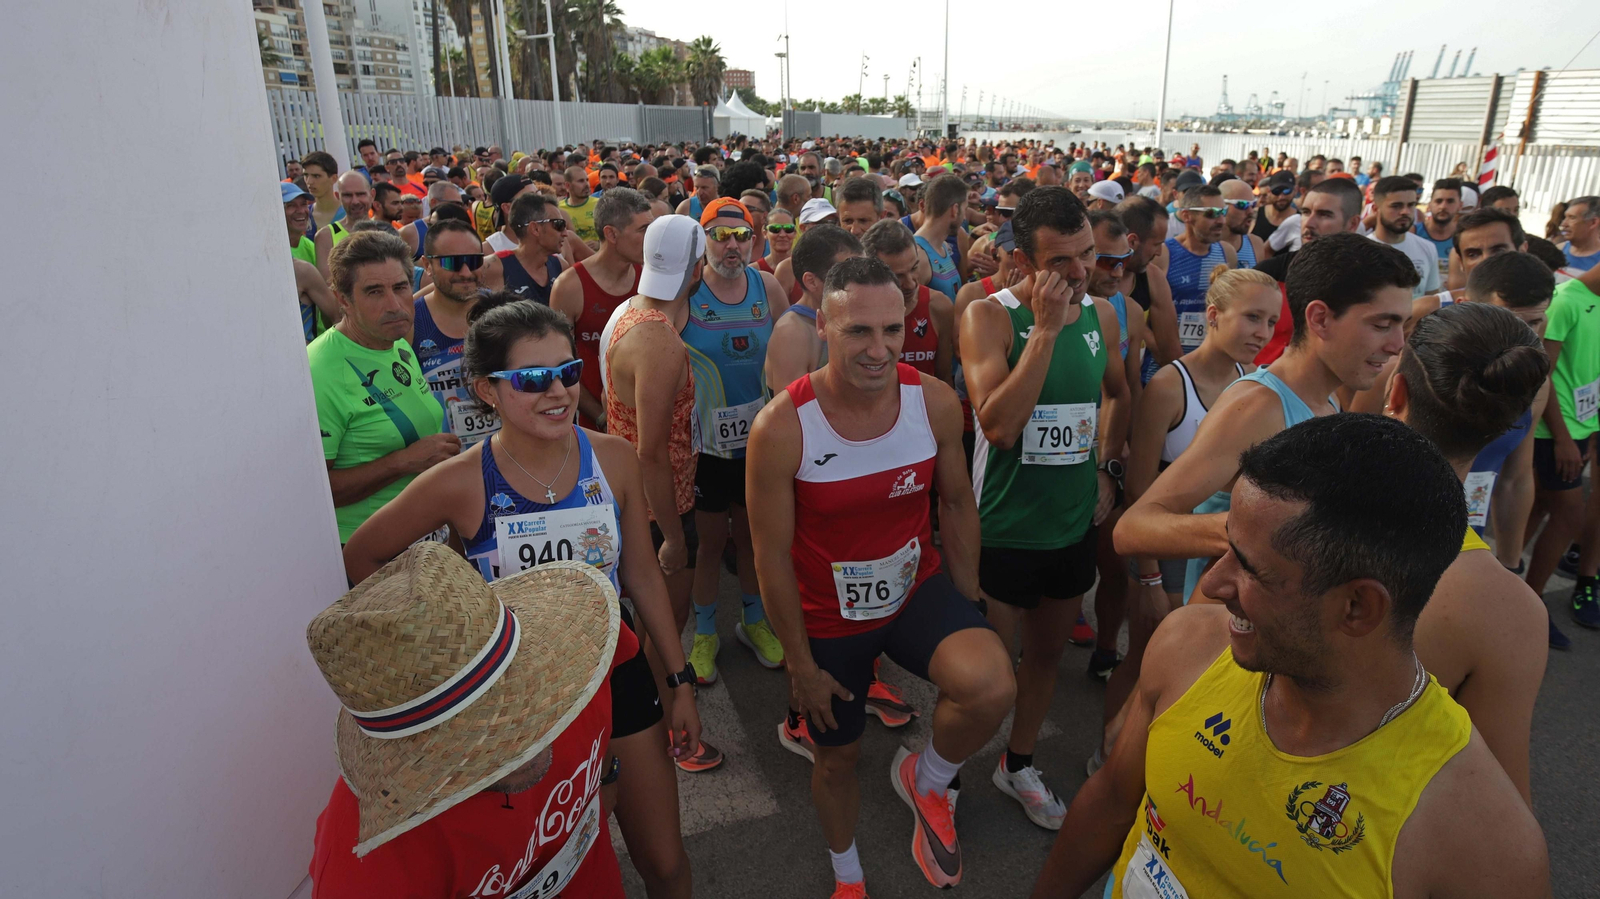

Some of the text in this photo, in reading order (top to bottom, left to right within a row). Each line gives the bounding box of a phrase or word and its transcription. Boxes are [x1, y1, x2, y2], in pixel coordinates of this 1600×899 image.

[1183, 324, 1204, 336] 778
[899, 350, 936, 362] PEDR
[465, 414, 494, 432] 939
[719, 419, 749, 439] 612
[1037, 425, 1072, 448] 790
[507, 521, 525, 535] XX
[524, 526, 547, 534] Popular
[519, 538, 573, 571] 940
[842, 566, 856, 576] XX
[846, 580, 890, 603] 576
[1194, 731, 1224, 759] mobel
[1175, 773, 1289, 886] Andalucía
[1145, 853, 1166, 886] XX
